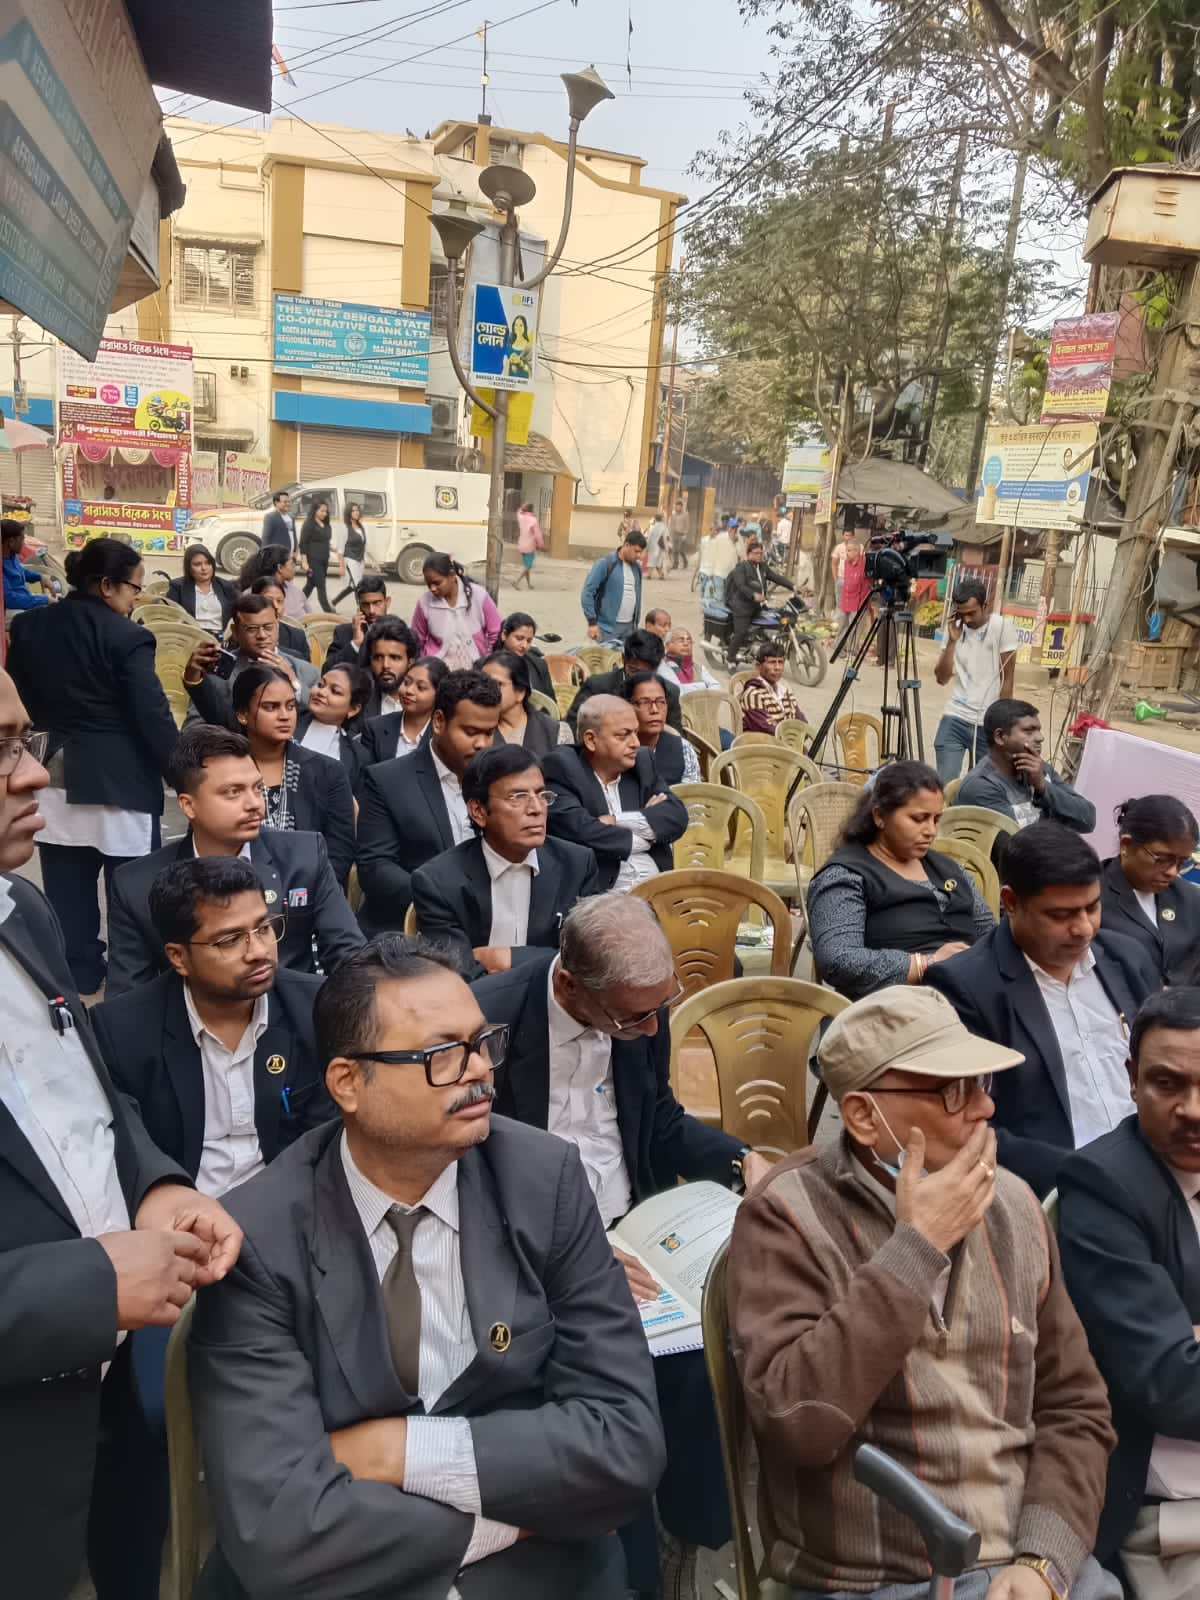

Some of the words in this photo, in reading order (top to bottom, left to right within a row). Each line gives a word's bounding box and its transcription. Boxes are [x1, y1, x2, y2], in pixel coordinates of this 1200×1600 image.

[278, 304, 303, 314] THE
[306, 307, 339, 319] WEST
[343, 311, 391, 326] BENGAL
[394, 318, 431, 330] STATE
[278, 314, 366, 332] CO-OPERATIVE
[369, 325, 402, 336] BANK
[405, 328, 430, 340] LTD.
[477, 322, 506, 335] গোল্ড
[313, 338, 337, 348] OFFICE
[478, 334, 504, 348] লোন
[373, 345, 394, 355] MAIN
[83, 503, 120, 517] বারাসাত
[121, 504, 151, 521] বিবেক
[152, 508, 172, 521] সংঘ
[1049, 628, 1064, 650] 1
